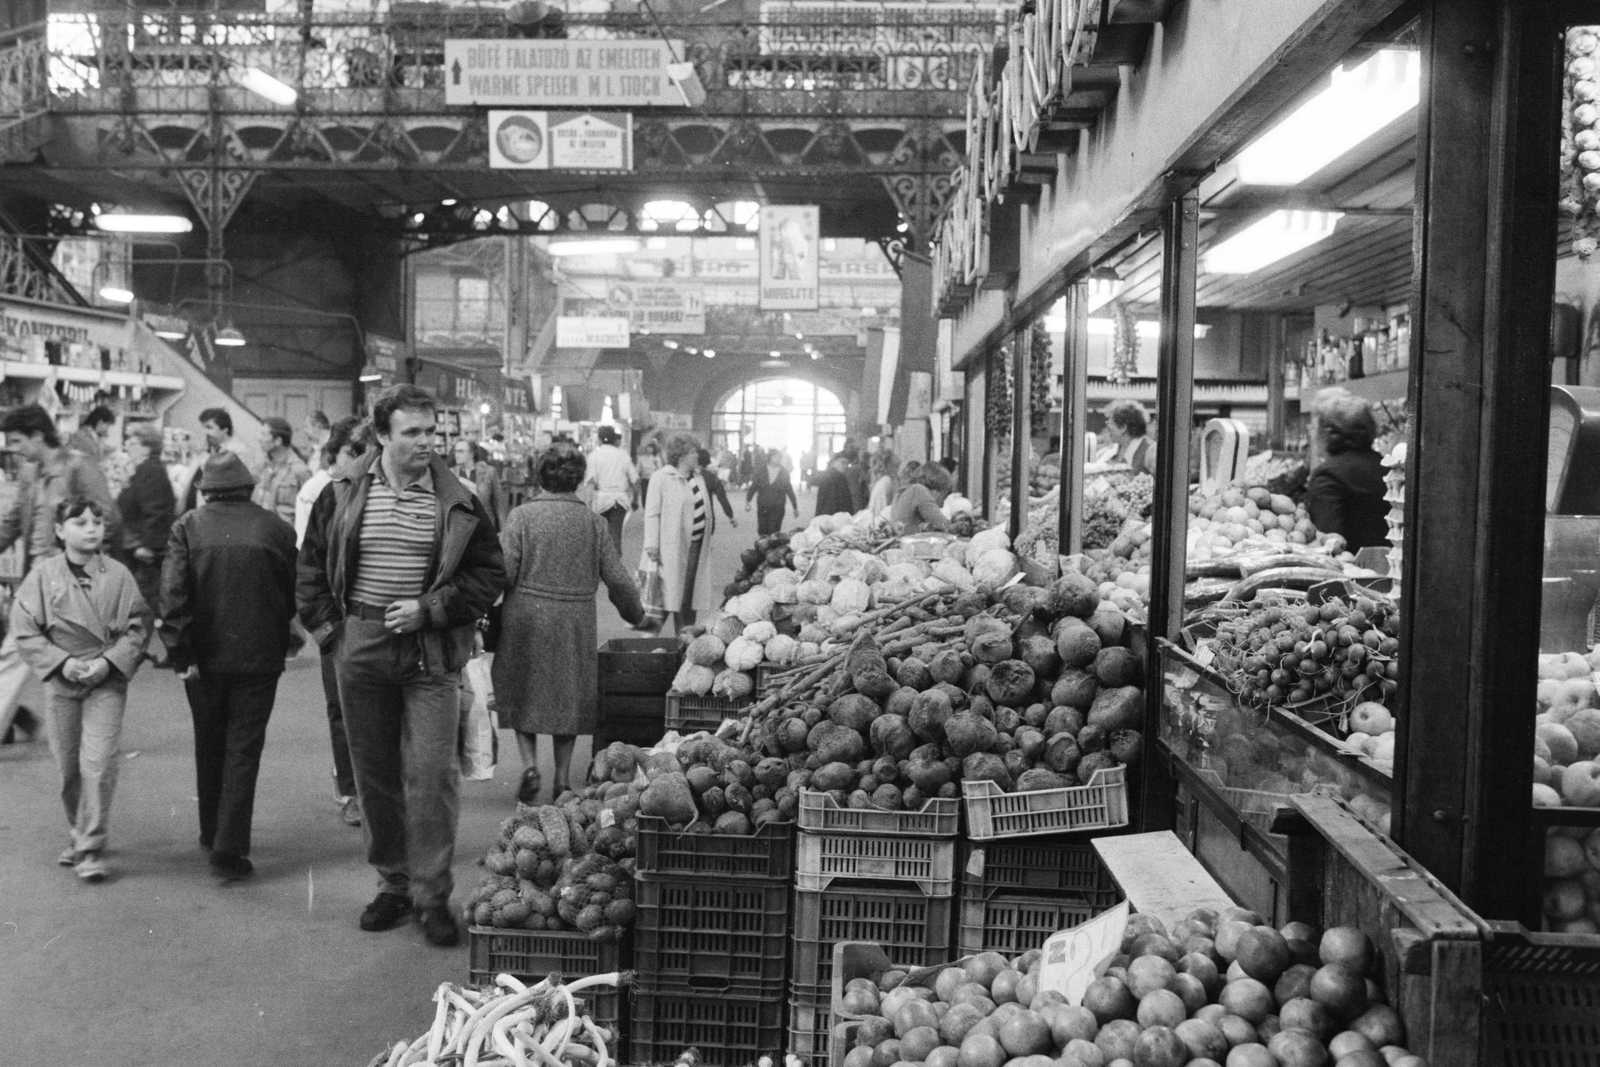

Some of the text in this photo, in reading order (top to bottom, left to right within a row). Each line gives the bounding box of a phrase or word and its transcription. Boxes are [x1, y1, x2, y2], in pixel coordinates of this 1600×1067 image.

[467, 43, 661, 69] BÜFÉ FALATOZÓ AZ EMELETEN
[527, 75, 579, 97] SPEISEN
[619, 75, 661, 97] STOCK
